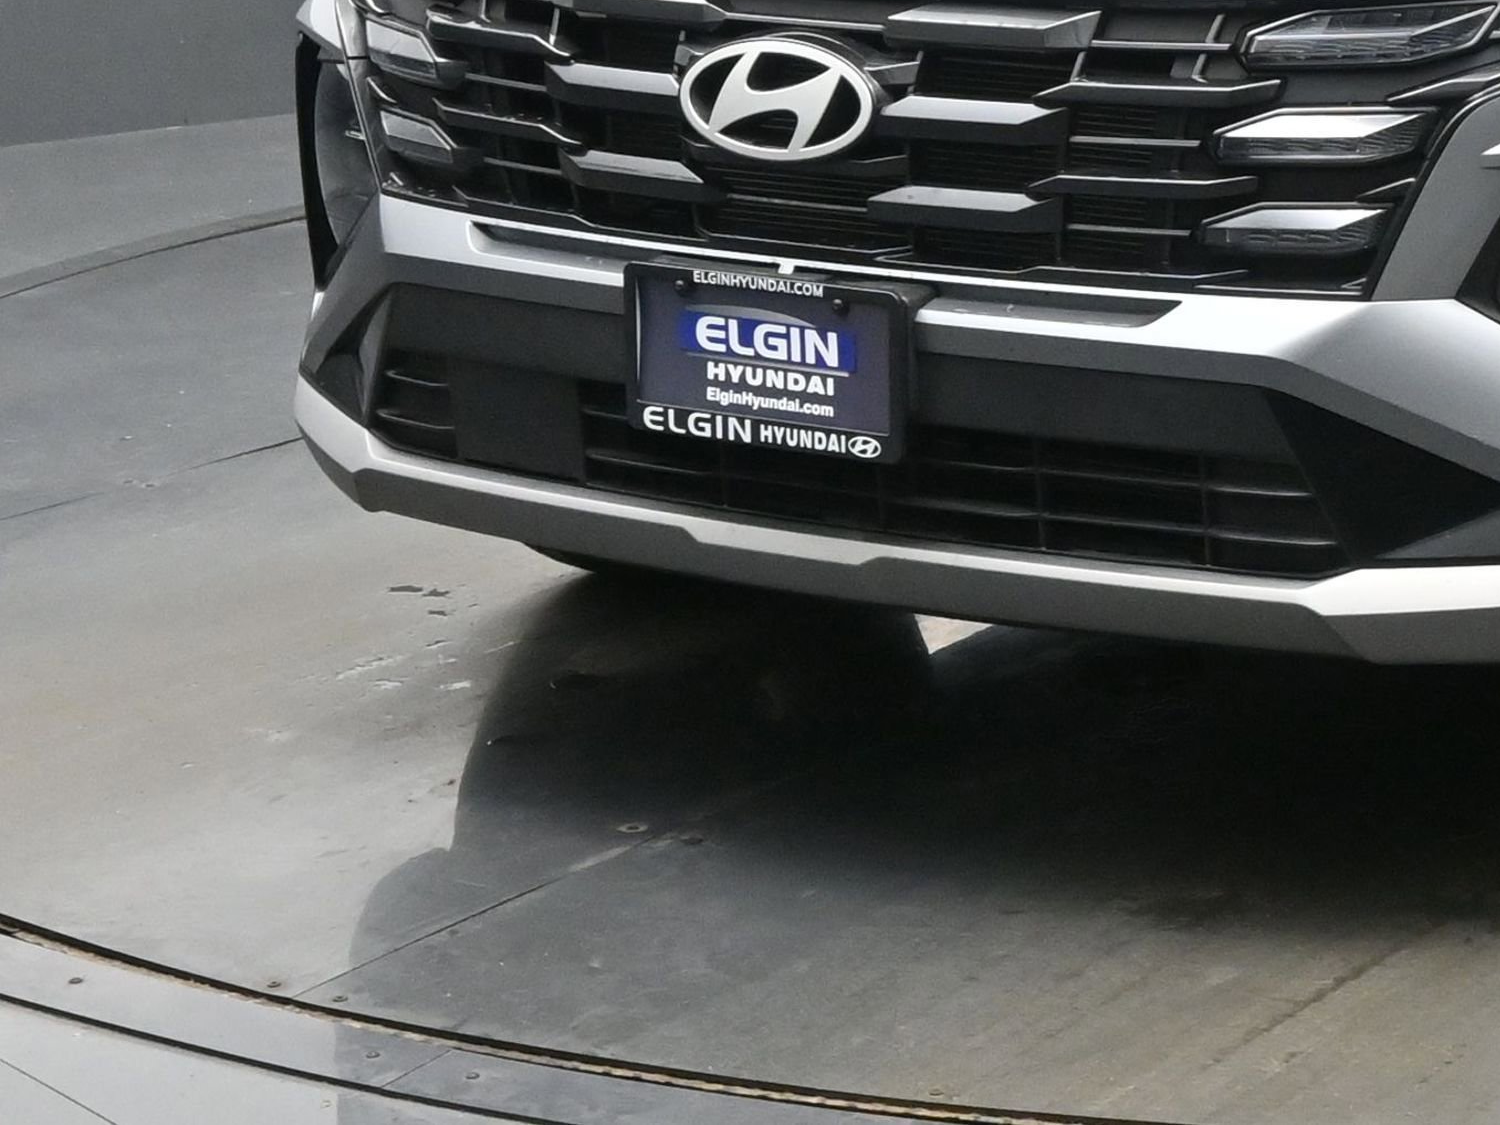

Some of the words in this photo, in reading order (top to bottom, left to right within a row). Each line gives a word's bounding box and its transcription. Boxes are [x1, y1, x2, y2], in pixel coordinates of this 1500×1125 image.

[693, 271, 824, 298] ELGINHYUNDAI.COM
[695, 316, 839, 368] ELGIN
[706, 362, 834, 396] HYUNDAI
[706, 387, 834, 417] ElginHyundai.com
[642, 406, 751, 443] ELGIN
[759, 423, 847, 454] HYUNDAI
